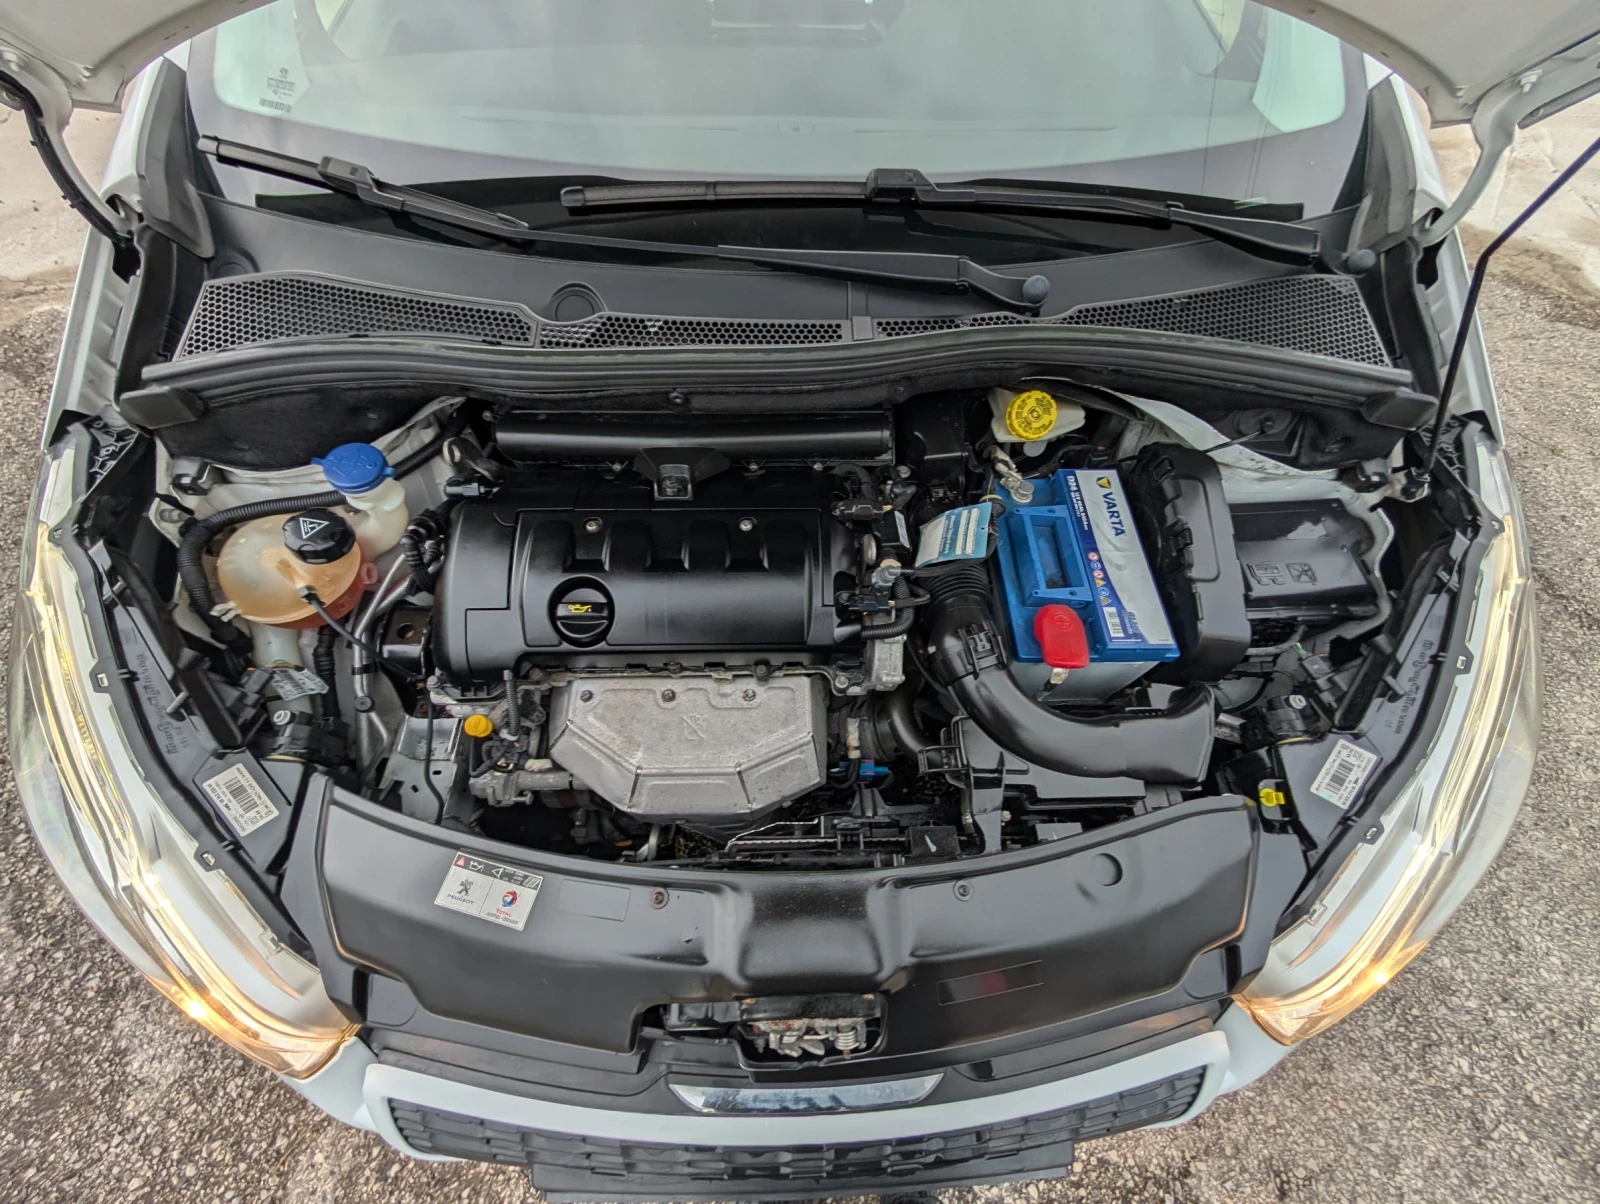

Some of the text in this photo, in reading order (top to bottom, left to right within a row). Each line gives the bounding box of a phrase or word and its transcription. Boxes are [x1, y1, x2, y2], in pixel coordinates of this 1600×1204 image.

[1066, 475, 1077, 491] D24
[1102, 491, 1126, 537] VARTA
[447, 894, 474, 904] PEUGEOT
[495, 908, 512, 917] TOTAL
